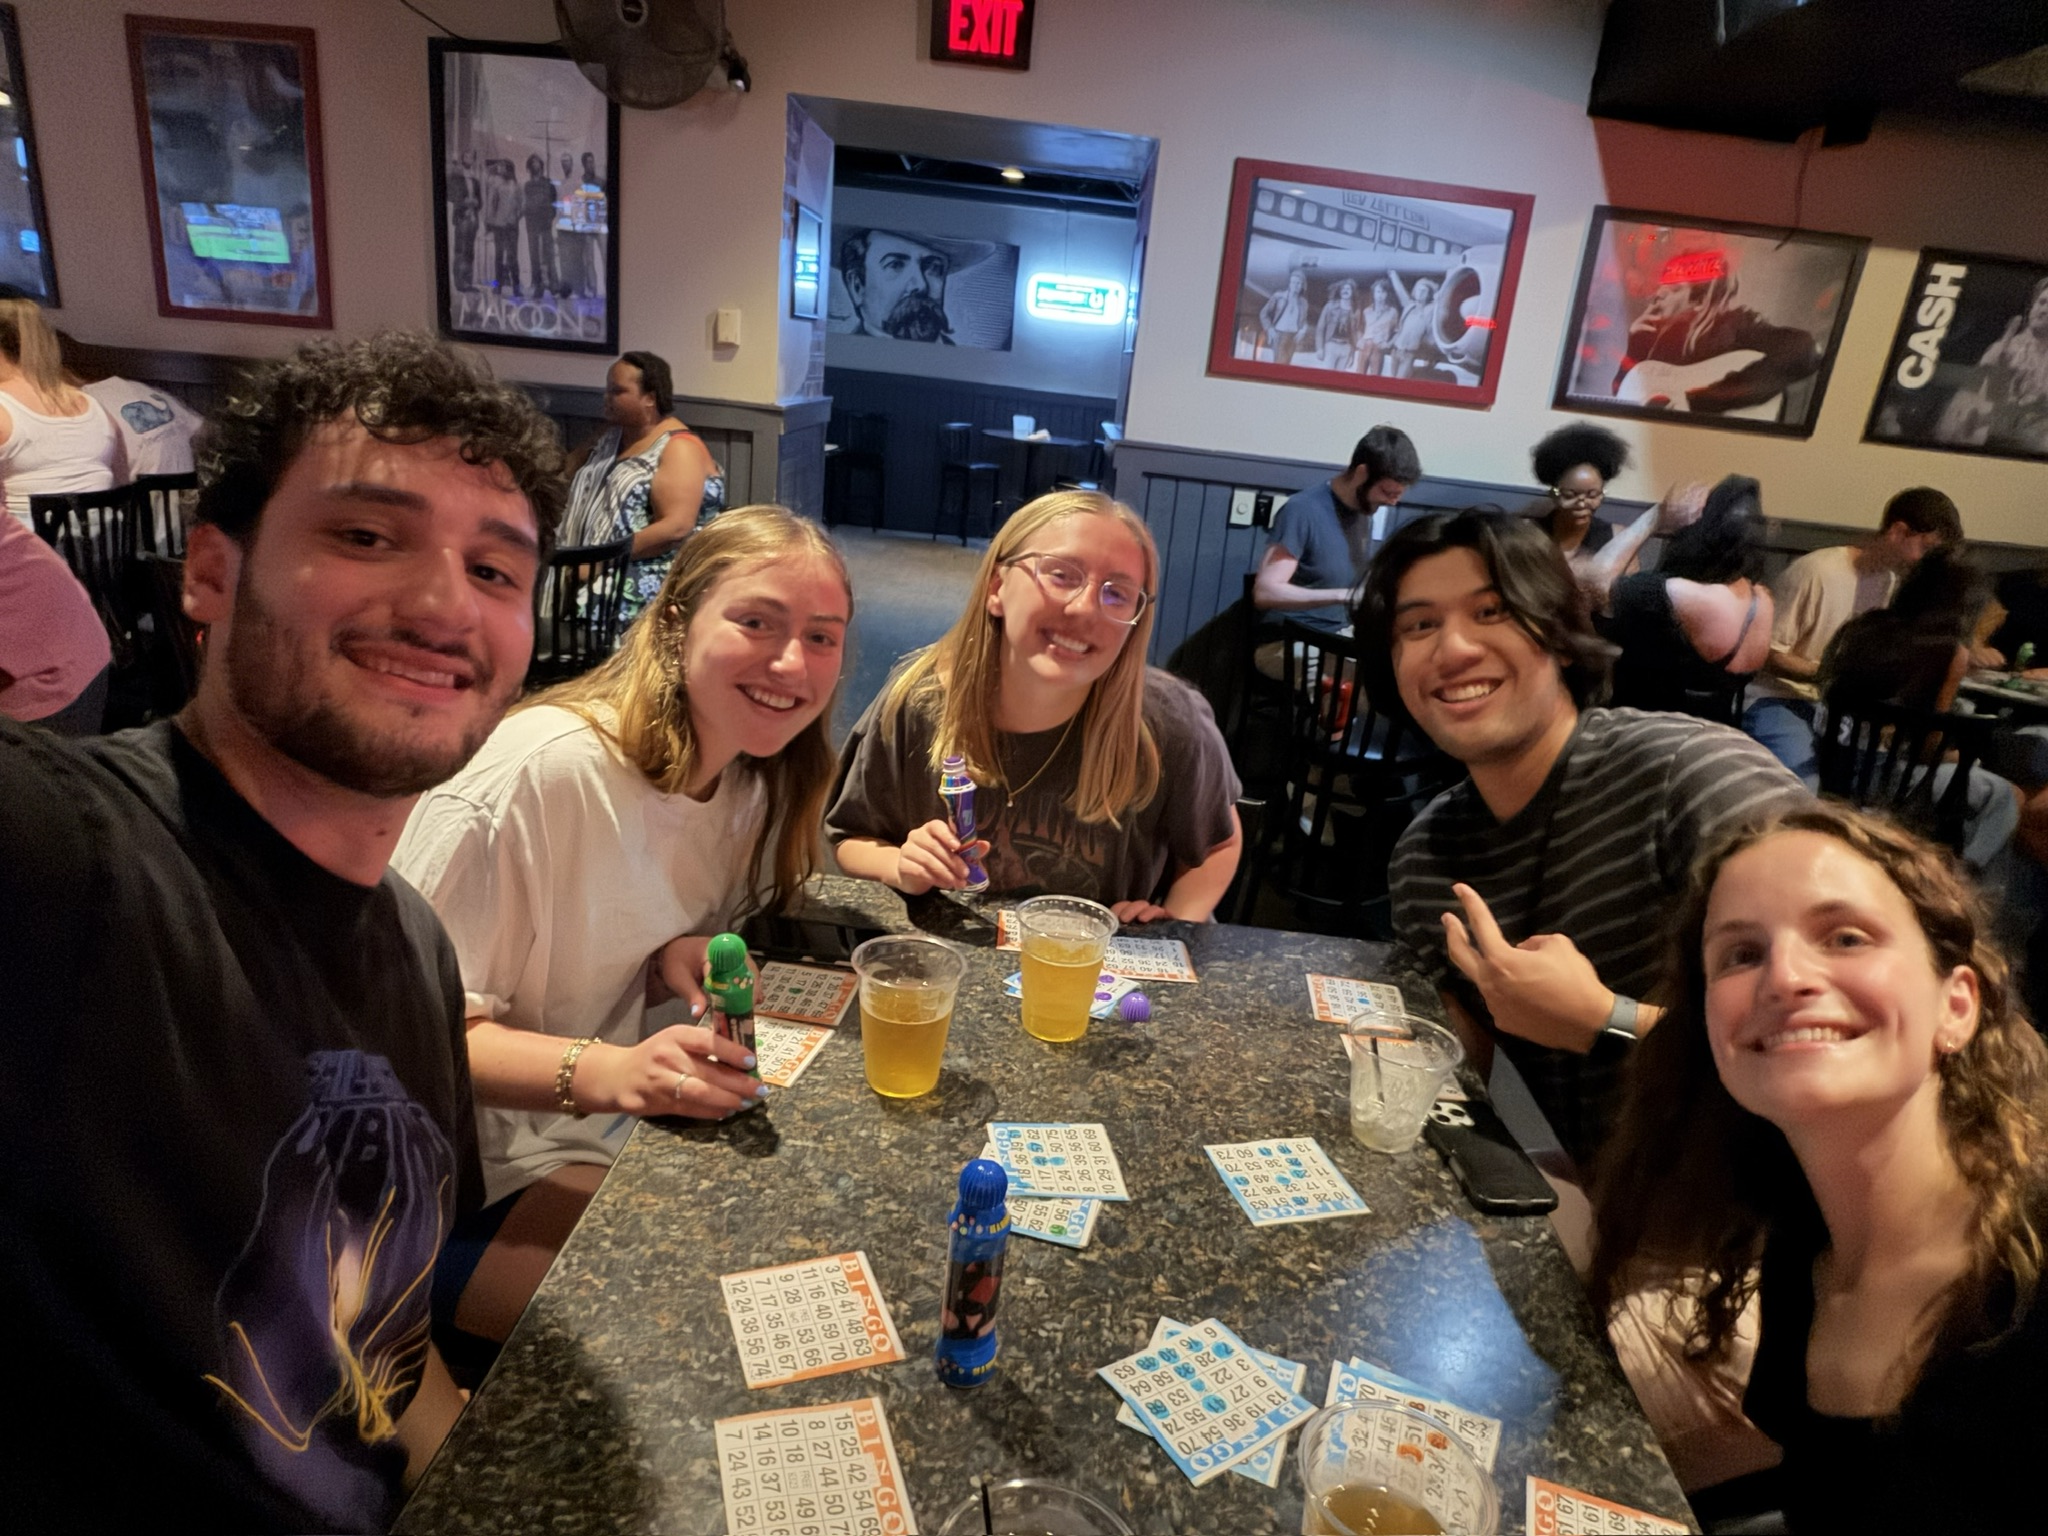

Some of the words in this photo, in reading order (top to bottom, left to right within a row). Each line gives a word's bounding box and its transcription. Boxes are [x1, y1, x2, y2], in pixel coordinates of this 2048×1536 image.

[948, 0, 1023, 55] EXIT
[459, 295, 584, 338] MAROON
[1897, 263, 1967, 388] CASH
[771, 1032, 786, 1041] 30
[788, 1036, 802, 1044] 21
[763, 1042, 778, 1052] 36
[779, 1046, 794, 1055] 41
[771, 1056, 786, 1066] 50
[762, 1067, 777, 1076] 74
[1026, 1129, 1040, 1139] 62
[1045, 1129, 1059, 1139] 75
[1063, 1129, 1078, 1139] 65
[1082, 1128, 1097, 1139] 69
[1010, 1141, 1024, 1151] 49
[1049, 1142, 1063, 1152] 50
[1068, 1142, 1082, 1151] 56
[1087, 1141, 1102, 1151] 60
[1235, 1148, 1253, 1158] 60
[1295, 1143, 1311, 1152] 13
[1014, 1153, 1028, 1165] 36
[1072, 1154, 1087, 1165] 39
[1091, 1155, 1107, 1165] 31
[1215, 1149, 1234, 1160] 73
[1309, 1155, 1317, 1163] 1
[1223, 1162, 1242, 1172] 70
[1244, 1161, 1262, 1170] 53
[1264, 1158, 1282, 1168] 38
[1017, 1168, 1031, 1180] 18
[1037, 1169, 1051, 1179] 17
[1057, 1169, 1072, 1181] 24
[1076, 1169, 1092, 1181] 26
[1096, 1168, 1111, 1181] 29
[1253, 1174, 1269, 1183] 49
[1314, 1167, 1330, 1176] 11
[1101, 1184, 1116, 1194] 10
[1261, 1185, 1280, 1194] 56
[1281, 1183, 1301, 1192] 32
[1305, 1181, 1320, 1190] 17
[1326, 1179, 1337, 1187] 5
[1240, 1187, 1260, 1197] 72
[1312, 1192, 1331, 1202] 28
[1333, 1191, 1350, 1199] 10
[1012, 1198, 1028, 1212] 50
[1249, 1199, 1268, 1210] 63
[1272, 1197, 1290, 1206] 51
[1032, 1204, 1048, 1217] 55
[1053, 1207, 1069, 1221] 56
[1027, 1218, 1044, 1231] 62
[801, 1266, 819, 1279] 11
[824, 1265, 841, 1273] 3
[754, 1277, 771, 1285] 7
[778, 1273, 794, 1282] 9
[730, 1279, 748, 1294] 12
[807, 1284, 826, 1299] 16
[830, 1279, 849, 1295] 22
[760, 1293, 778, 1306] 17
[783, 1288, 802, 1304] 28
[734, 1297, 754, 1313] 24
[814, 1303, 833, 1319] 40
[838, 1299, 857, 1313] 41
[843, 1262, 891, 1351] BINGO
[740, 1316, 759, 1334] 38
[765, 1312, 784, 1329] 35
[845, 1318, 865, 1334] 48
[796, 1328, 815, 1344] 53
[820, 1322, 840, 1339] 59
[1203, 1326, 1217, 1338] 6
[745, 1337, 765, 1355] 56
[772, 1333, 791, 1349] 46
[852, 1337, 872, 1356] 63
[1178, 1335, 1201, 1351] 16
[1216, 1340, 1234, 1354] 7
[803, 1347, 823, 1366] 66
[827, 1341, 847, 1361] 70
[1156, 1346, 1179, 1362] 40
[1194, 1350, 1216, 1367] 28
[751, 1358, 771, 1376] 74
[777, 1353, 797, 1370] 67
[1235, 1358, 1250, 1371] 3
[1112, 1364, 1136, 1379] 63
[1151, 1370, 1174, 1387] 58
[1209, 1366, 1233, 1384] 22
[1128, 1379, 1151, 1396] 64
[1252, 1375, 1267, 1387] 9
[1166, 1388, 1190, 1406] 53
[1229, 1384, 1250, 1403] 27
[1266, 1390, 1287, 1406] 13
[1144, 1398, 1167, 1416] 68
[1206, 1397, 1228, 1413] 41
[1244, 1402, 1265, 1418] 19
[834, 1412, 853, 1430] 15
[1183, 1407, 1207, 1425] 55
[1222, 1413, 1246, 1431] 36
[752, 1422, 772, 1440] 14
[780, 1418, 799, 1436] 10
[807, 1420, 826, 1430] 8
[1161, 1417, 1185, 1435] 74
[1459, 1420, 1475, 1437] 75
[724, 1429, 742, 1439] 7
[1189, 1406, 1301, 1471] BINGO
[1199, 1425, 1224, 1444] 54
[812, 1440, 833, 1460] 27
[839, 1436, 860, 1457] 25
[1177, 1435, 1202, 1455] 70
[727, 1450, 747, 1471] 24
[756, 1447, 776, 1466] 16
[785, 1444, 804, 1463] 18
[818, 1466, 839, 1487] 44
[847, 1463, 867, 1484] 42
[856, 1411, 905, 1535] BINGO
[731, 1477, 751, 1499] 43
[760, 1472, 781, 1492] 37
[795, 1497, 816, 1518] 49
[823, 1494, 845, 1515] 50
[852, 1489, 874, 1511] 54
[1556, 1493, 1574, 1515] 67
[734, 1505, 755, 1528] 52
[765, 1500, 786, 1521] 53
[1582, 1505, 1600, 1523] 61
[1610, 1511, 1626, 1532] 69
